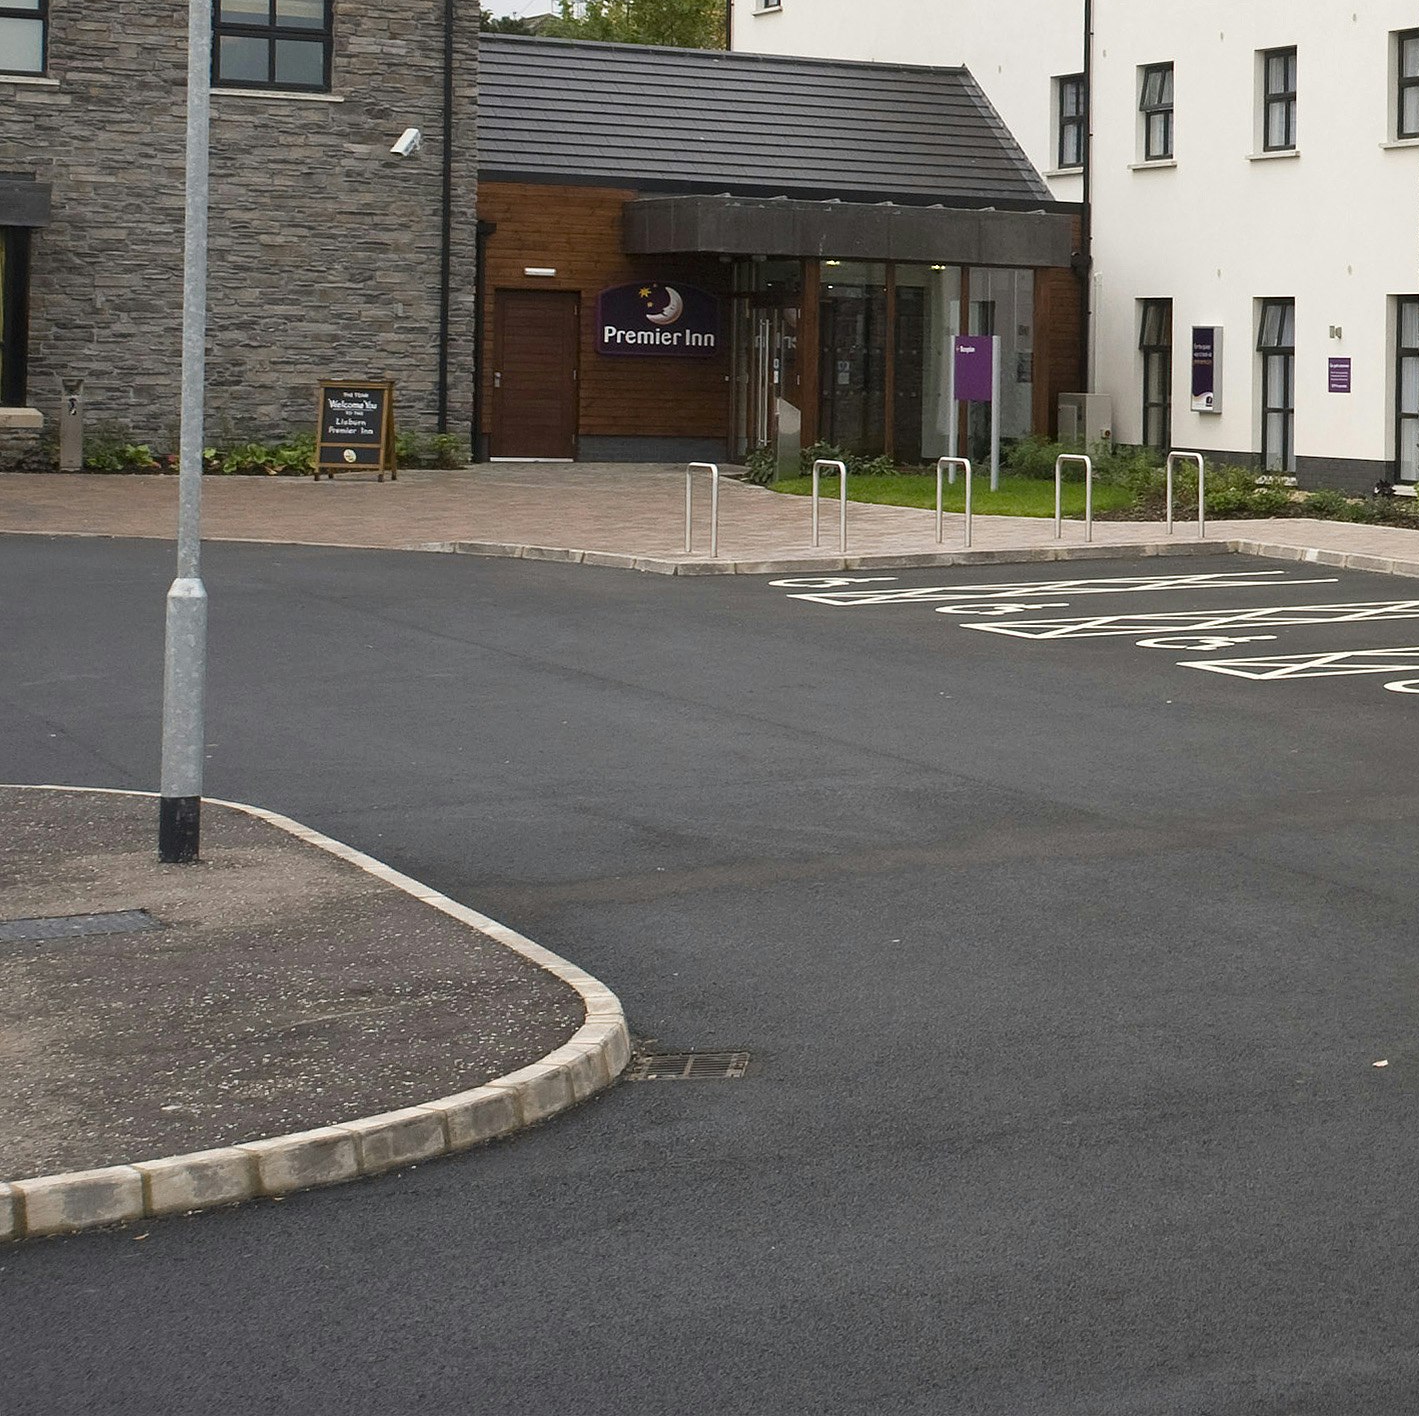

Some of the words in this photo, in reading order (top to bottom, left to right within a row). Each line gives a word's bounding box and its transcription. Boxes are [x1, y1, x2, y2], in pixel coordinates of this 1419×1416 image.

[603, 326, 682, 345] Premier
[685, 329, 715, 347] Inn
[327, 398, 364, 409] Welcome
